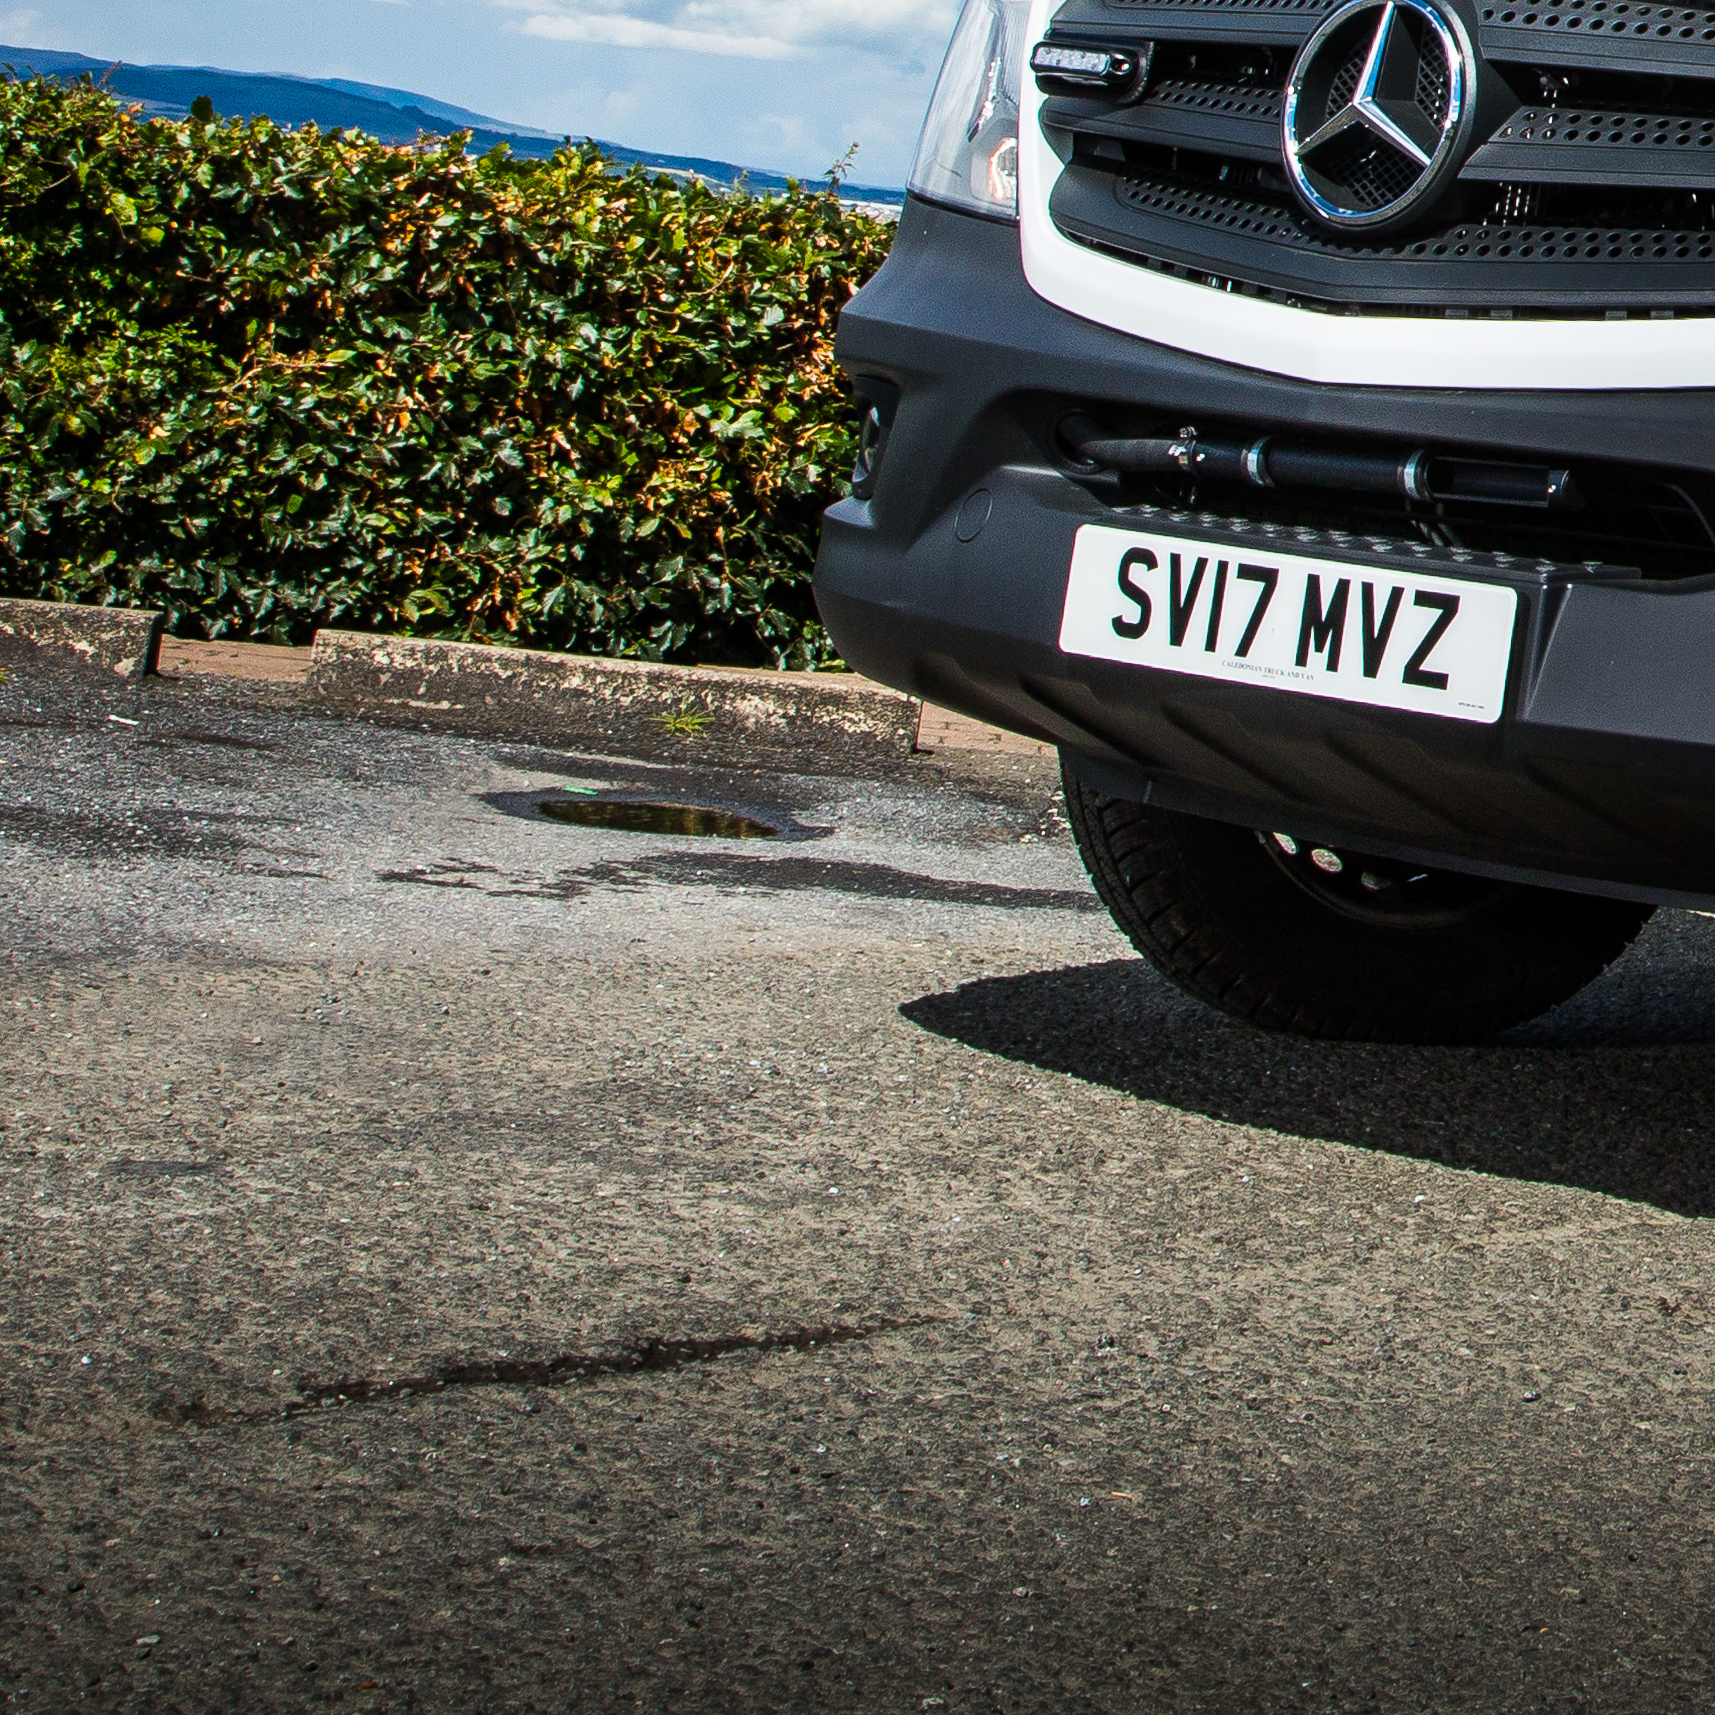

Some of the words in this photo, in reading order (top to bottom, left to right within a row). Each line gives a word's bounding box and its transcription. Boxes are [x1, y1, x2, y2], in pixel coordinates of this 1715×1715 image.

[1111, 546, 1280, 659] SV17
[1294, 572, 1461, 690] MVZ
[1221, 660, 1263, 673] CALEDONIAN
